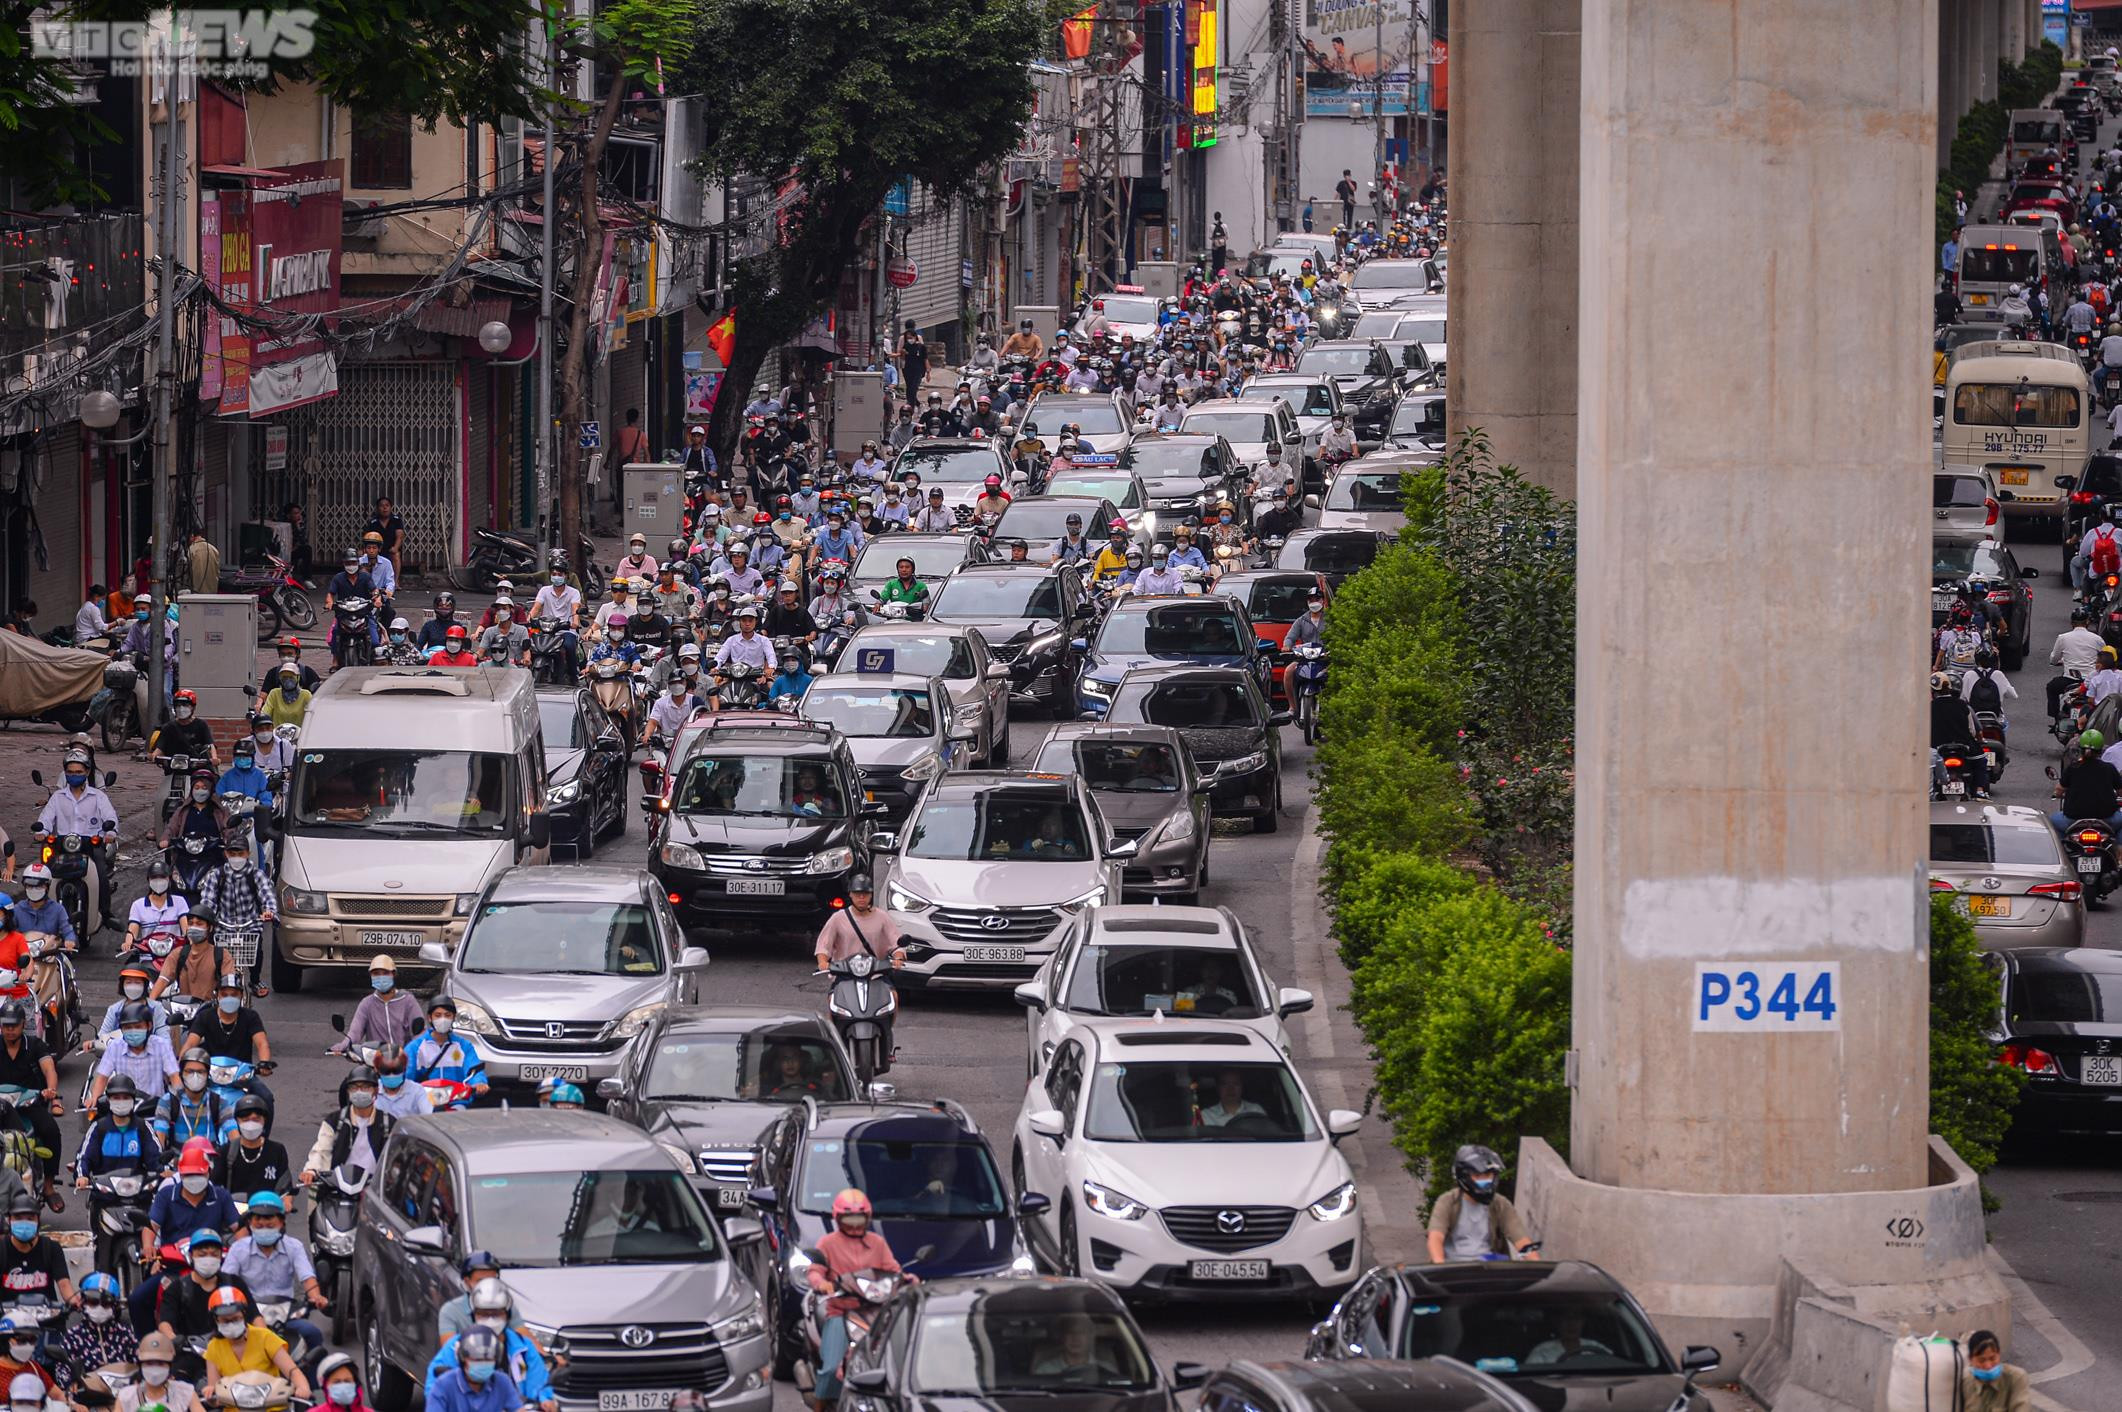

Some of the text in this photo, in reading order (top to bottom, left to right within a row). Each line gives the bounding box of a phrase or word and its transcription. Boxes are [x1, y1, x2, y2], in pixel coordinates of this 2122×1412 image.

[1984, 432, 2047, 443] HYUNDAI
[2012, 444, 2044, 453] 175.77
[728, 882, 783, 893] 30E-311.17
[364, 933, 420, 945] 29B-074.10
[966, 948, 1023, 959] 30E-963.88
[1700, 971, 1837, 1021] P344
[2091, 1057, 2114, 1070] 30K
[524, 1066, 583, 1080] 30Y-7270
[2087, 1070, 2118, 1083] 5205
[264, 1165, 276, 1179] NY
[1195, 1263, 1264, 1278] 30E-045.54
